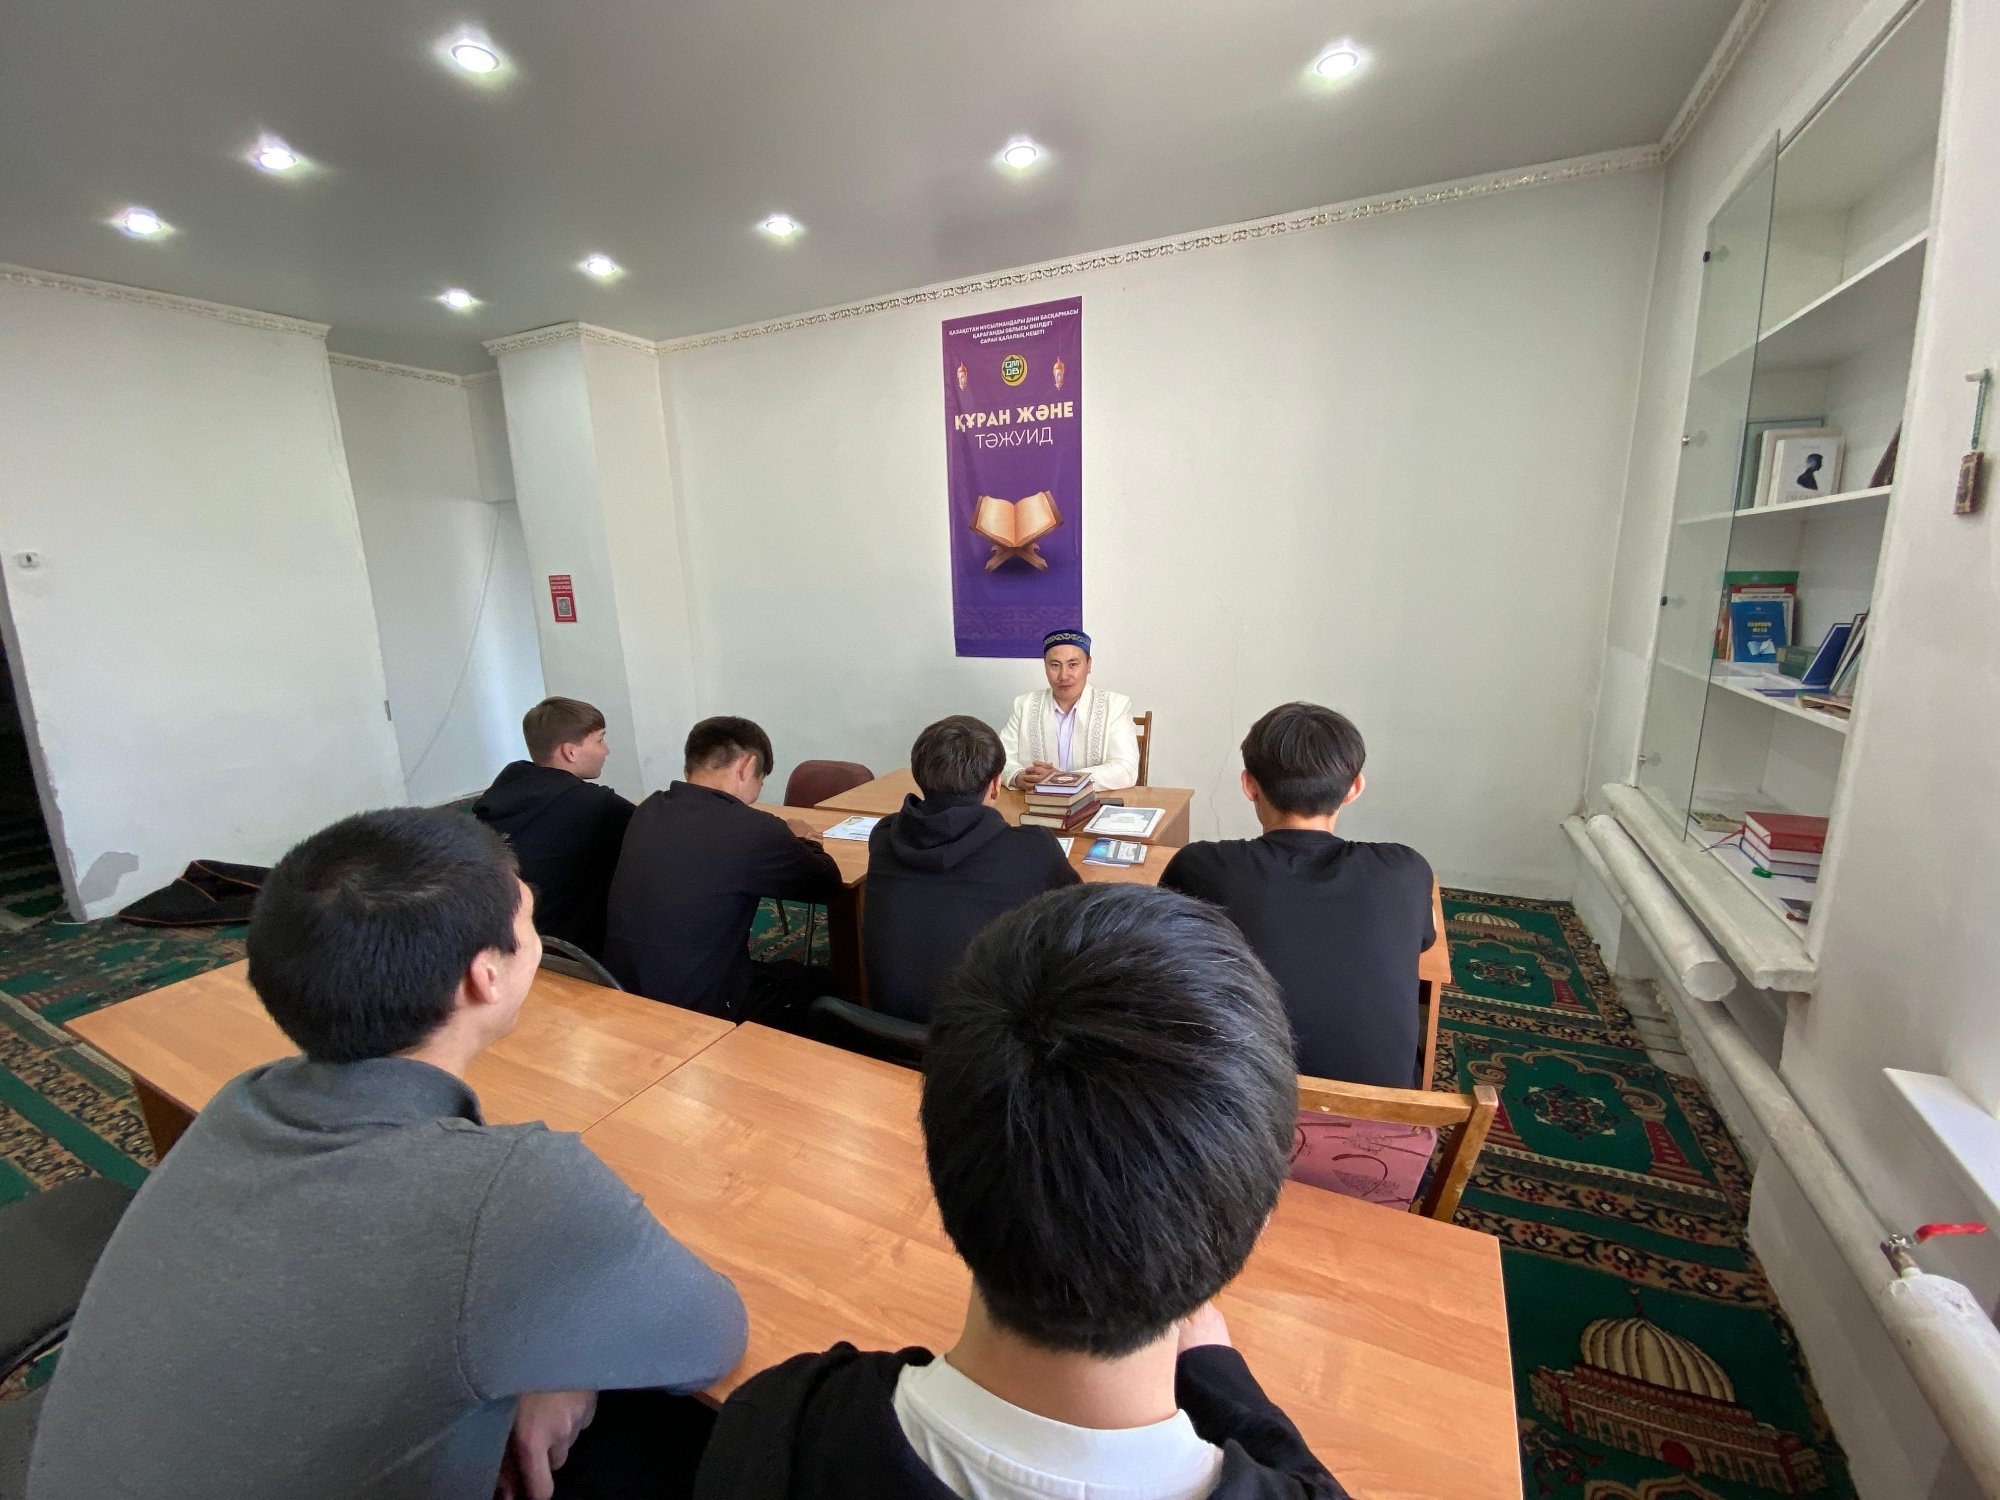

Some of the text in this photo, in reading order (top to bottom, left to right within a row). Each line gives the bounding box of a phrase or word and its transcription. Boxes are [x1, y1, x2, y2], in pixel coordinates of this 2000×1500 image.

[954, 401, 1074, 432] ҚҰРАН ЖӘНЕ
[975, 426, 1053, 449] ТӘЖУИД
